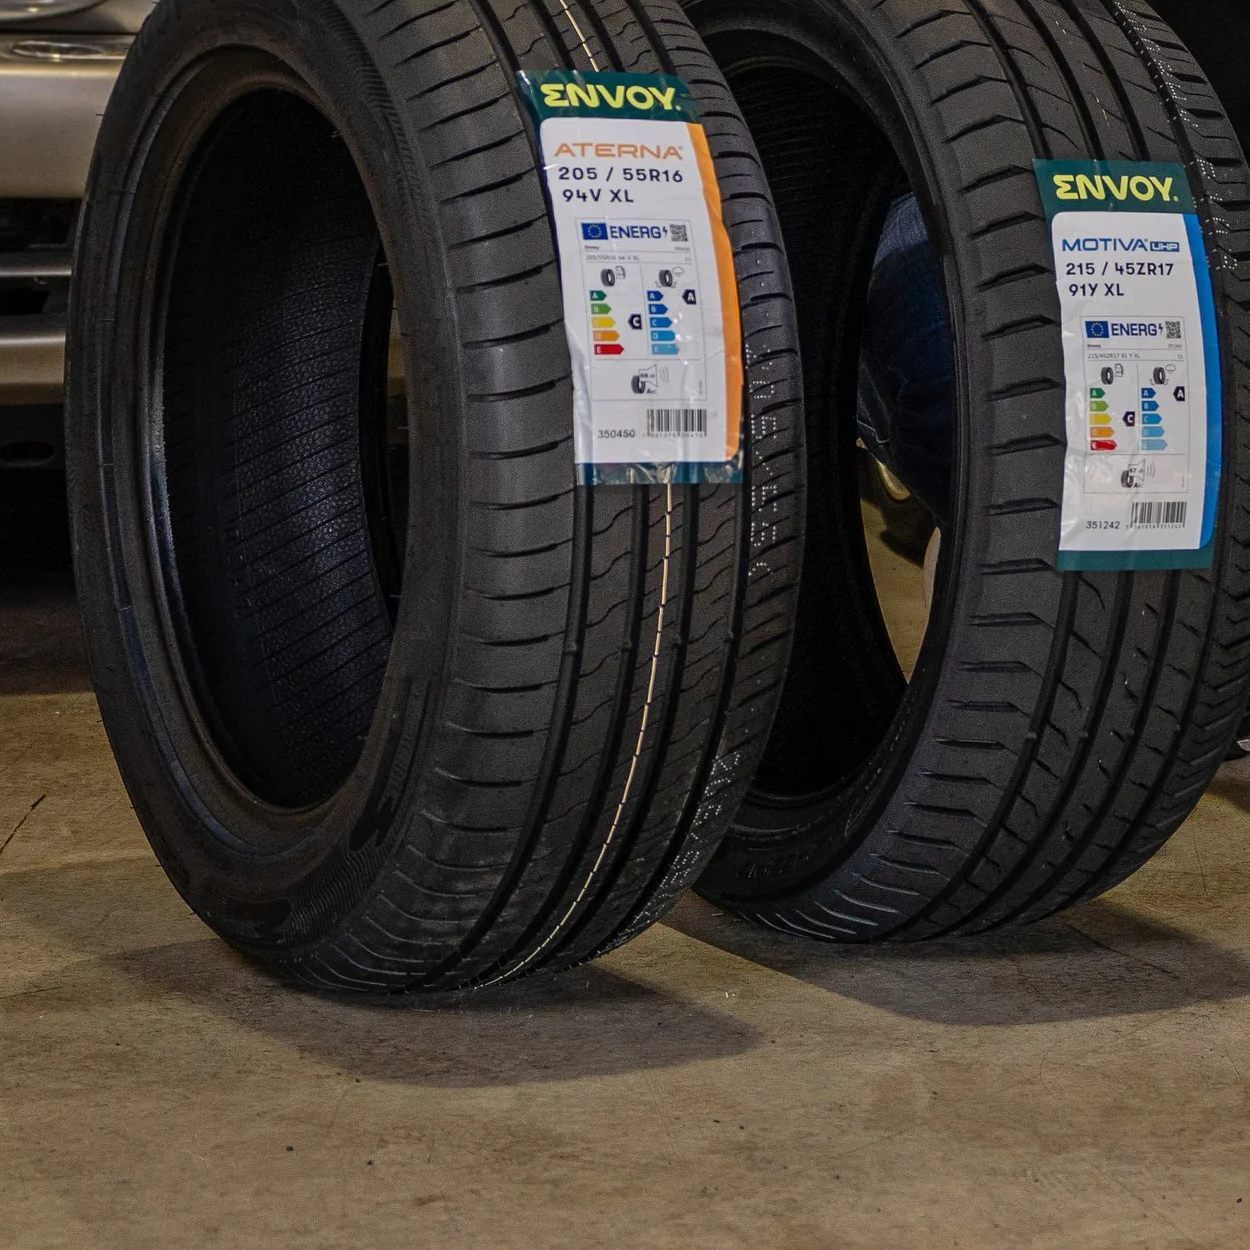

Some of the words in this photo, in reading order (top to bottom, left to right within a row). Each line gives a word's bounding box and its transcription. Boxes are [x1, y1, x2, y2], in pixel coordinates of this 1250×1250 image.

[540, 83, 679, 111] ENVOY
[554, 142, 683, 161] ATERNA
[558, 166, 598, 181] 205
[606, 166, 613, 182] /
[623, 168, 683, 183] 55R16
[1053, 174, 1174, 202] ENVOY
[562, 189, 601, 203] 94V
[609, 189, 634, 203] XL
[610, 225, 662, 239] ENERG
[1062, 238, 1147, 252] MOTIVA
[1066, 262, 1095, 276] 215
[1102, 261, 1109, 276] /
[1115, 262, 1174, 276] 45ZR17
[687, 293, 694, 301] A
[1069, 283, 1098, 297] 91Y
[1104, 283, 1124, 297] XL
[632, 317, 640, 326] C
[1111, 323, 1157, 337] ENERG
[1177, 390, 1184, 399] A
[1127, 414, 1134, 423] C
[598, 429, 635, 439] 350450
[1086, 521, 1121, 529] 351242
